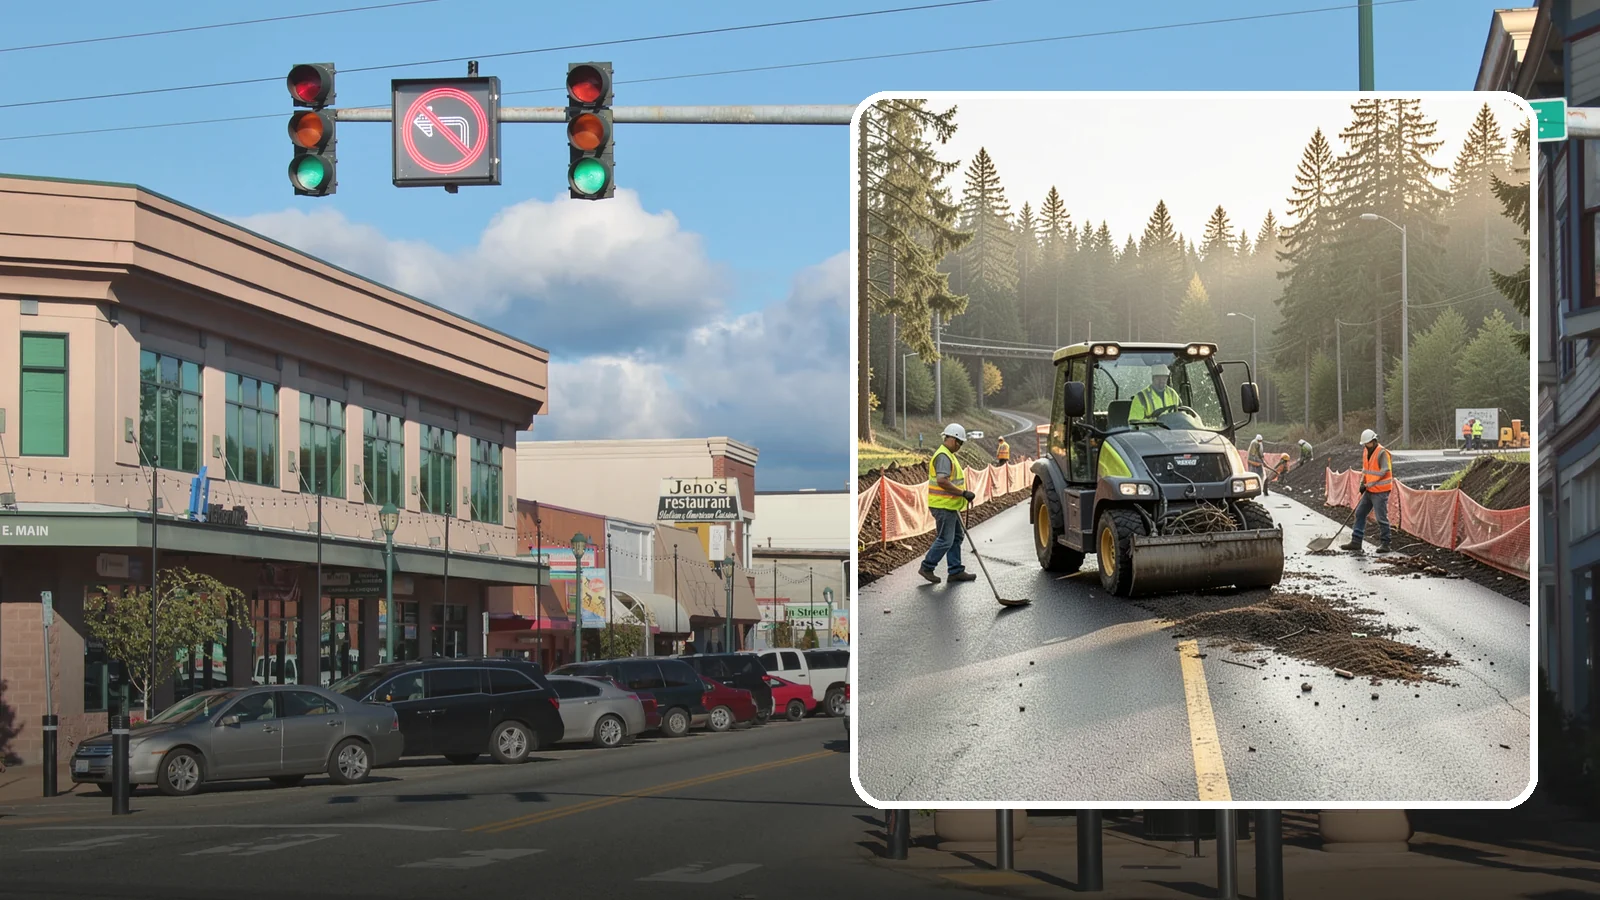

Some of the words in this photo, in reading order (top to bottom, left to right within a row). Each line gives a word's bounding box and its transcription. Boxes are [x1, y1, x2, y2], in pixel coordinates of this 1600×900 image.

[669, 480, 728, 495] Jeno's
[664, 496, 731, 509] restaurant
[2, 525, 13, 536] E.
[15, 525, 49, 536] MAIN
[797, 607, 828, 617] Street
[791, 619, 824, 627] lass
